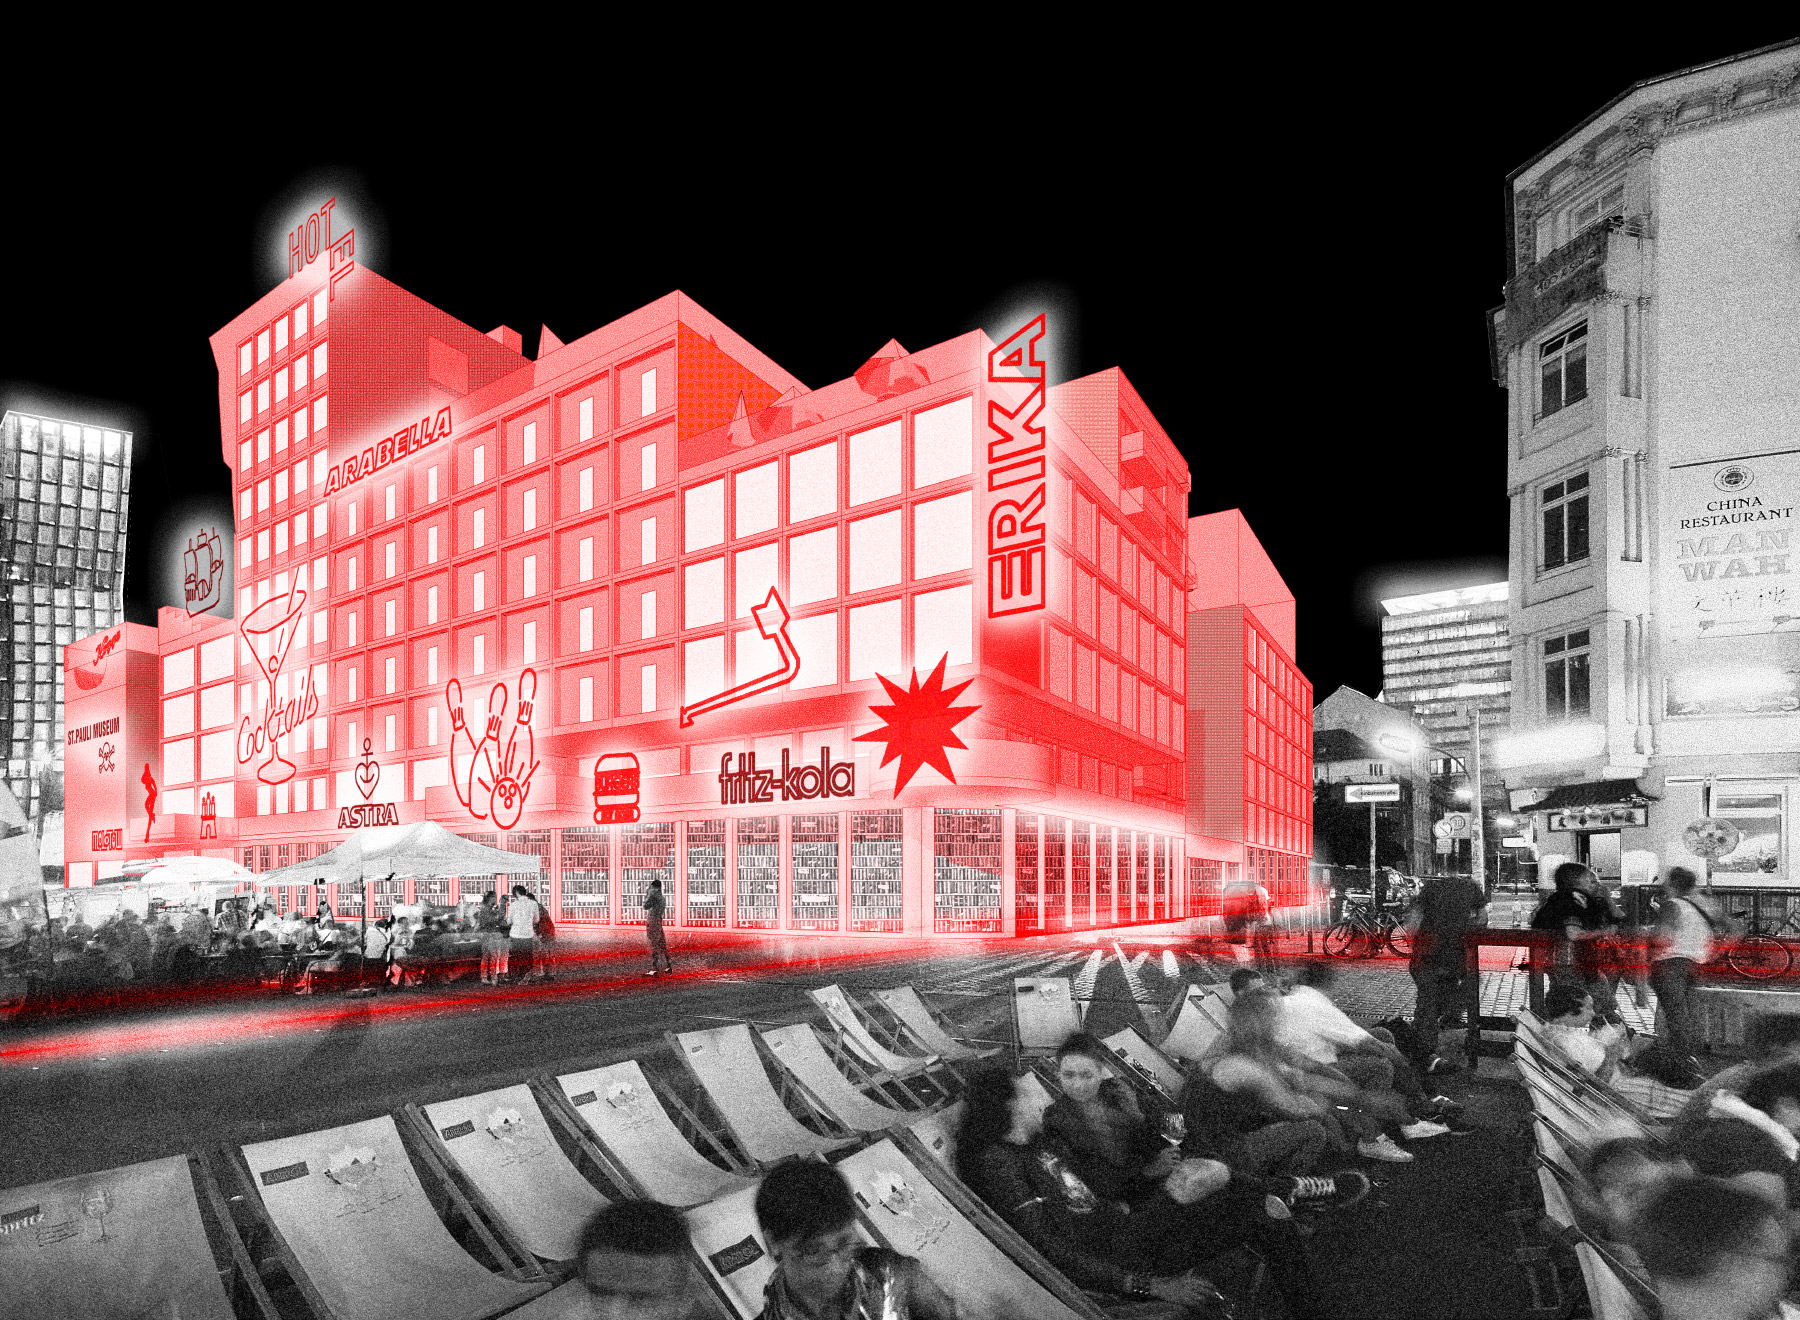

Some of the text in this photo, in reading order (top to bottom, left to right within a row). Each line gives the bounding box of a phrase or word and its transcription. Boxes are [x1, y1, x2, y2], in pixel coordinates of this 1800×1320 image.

[324, 406, 452, 497] ARABELLA
[988, 312, 1046, 618] ERIKA
[1680, 507, 1794, 529] RESTAURANT
[1706, 496, 1763, 511] CHINA
[1677, 528, 1794, 559] MAN
[1678, 554, 1791, 583] WAH
[93, 716, 120, 739] MUSEUM
[237, 664, 319, 764] Cocktails
[719, 746, 855, 805] fritz-kola
[338, 802, 399, 829] ASTRA
